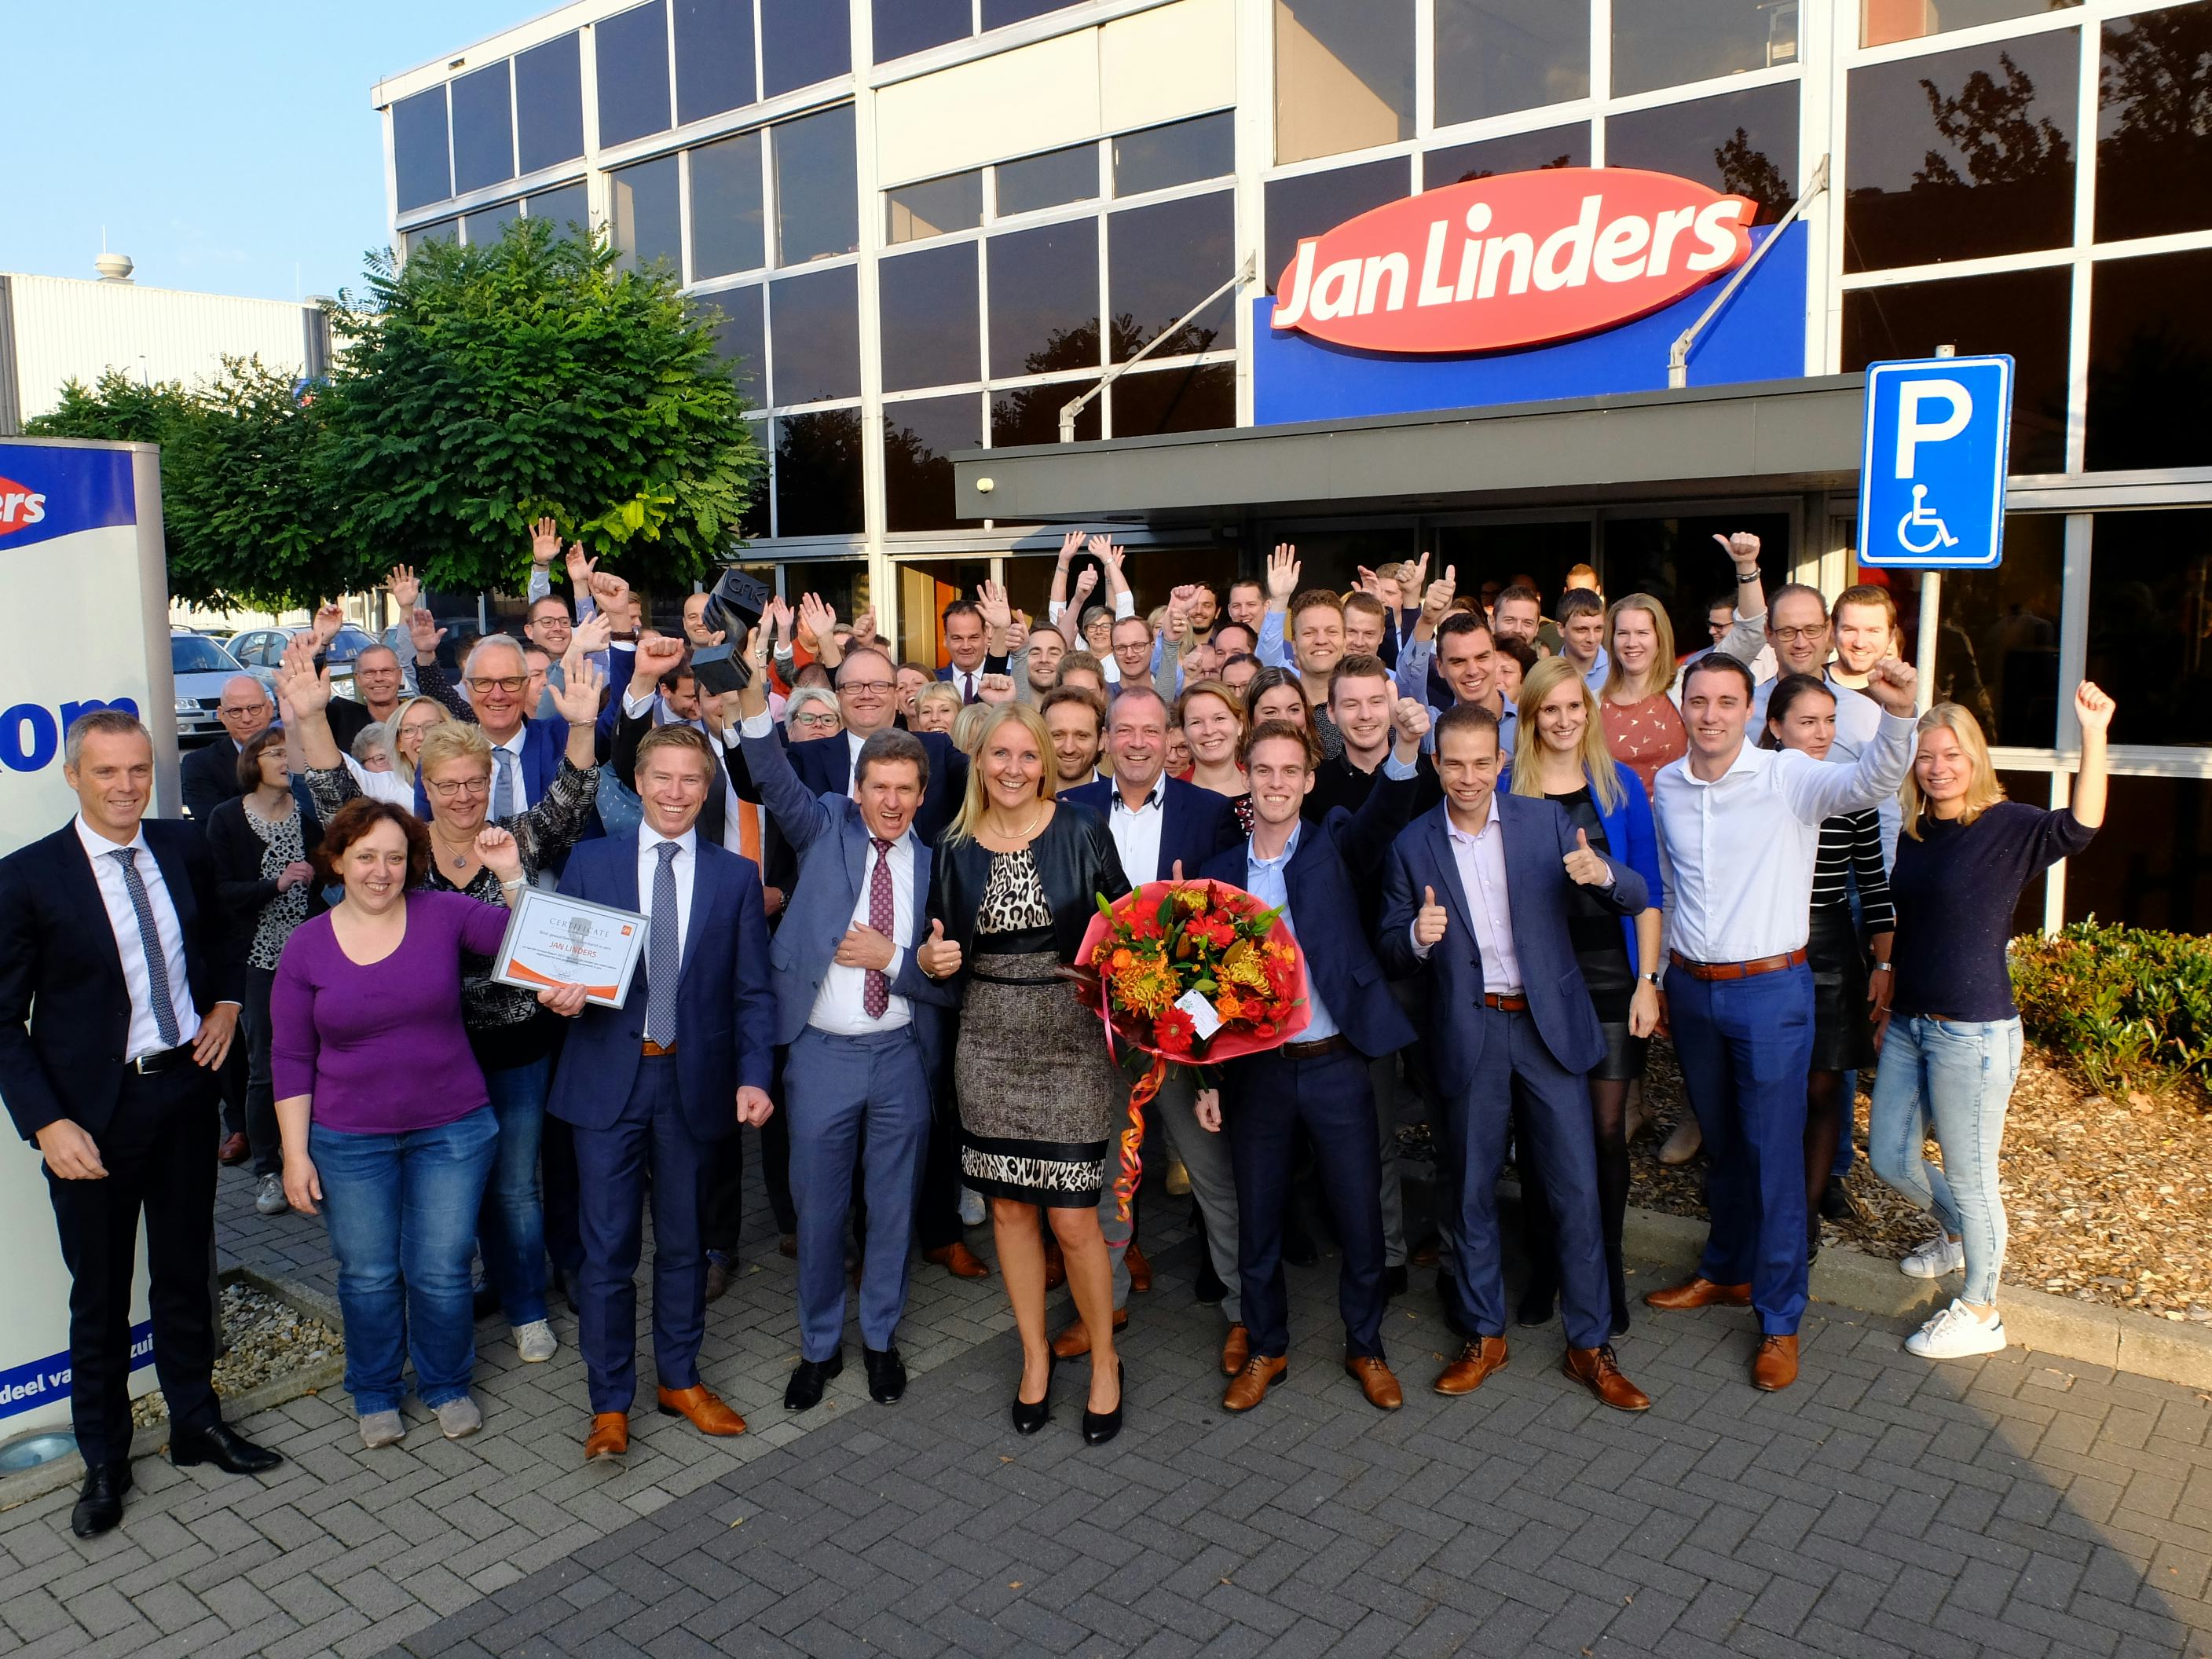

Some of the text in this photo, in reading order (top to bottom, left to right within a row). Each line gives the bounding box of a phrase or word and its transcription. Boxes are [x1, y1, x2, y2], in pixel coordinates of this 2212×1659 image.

[1274, 194, 1744, 326] Jan Linders
[1895, 379, 1973, 479] P
[0, 493, 46, 523] rs
[549, 917, 610, 938] CERTIFICATE
[549, 942, 597, 958] JAN LINDERS
[0, 1373, 46, 1404] deel
